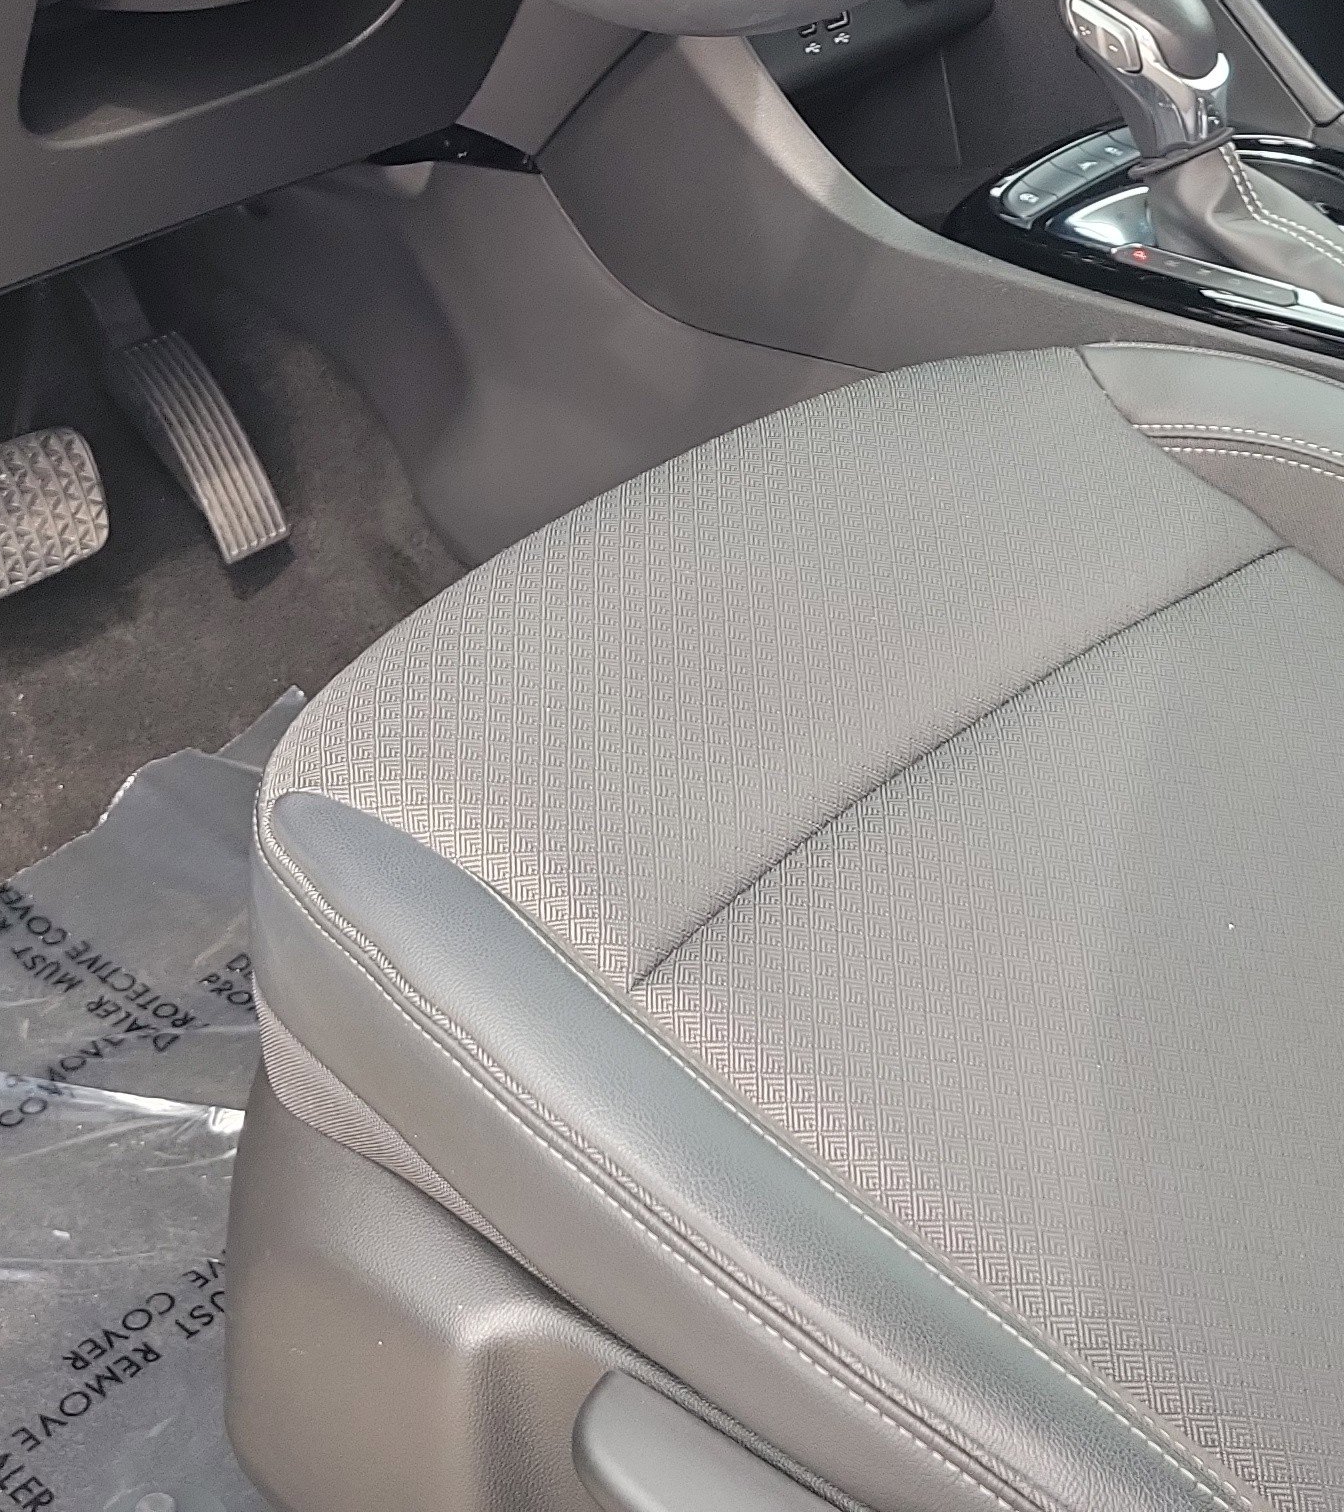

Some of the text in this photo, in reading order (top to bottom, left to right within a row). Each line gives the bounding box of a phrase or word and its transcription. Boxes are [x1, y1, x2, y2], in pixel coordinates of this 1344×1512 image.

[10, 945, 82, 992] MUST
[62, 1291, 176, 1371] COVER
[11, 1341, 163, 1453] REMOVE
